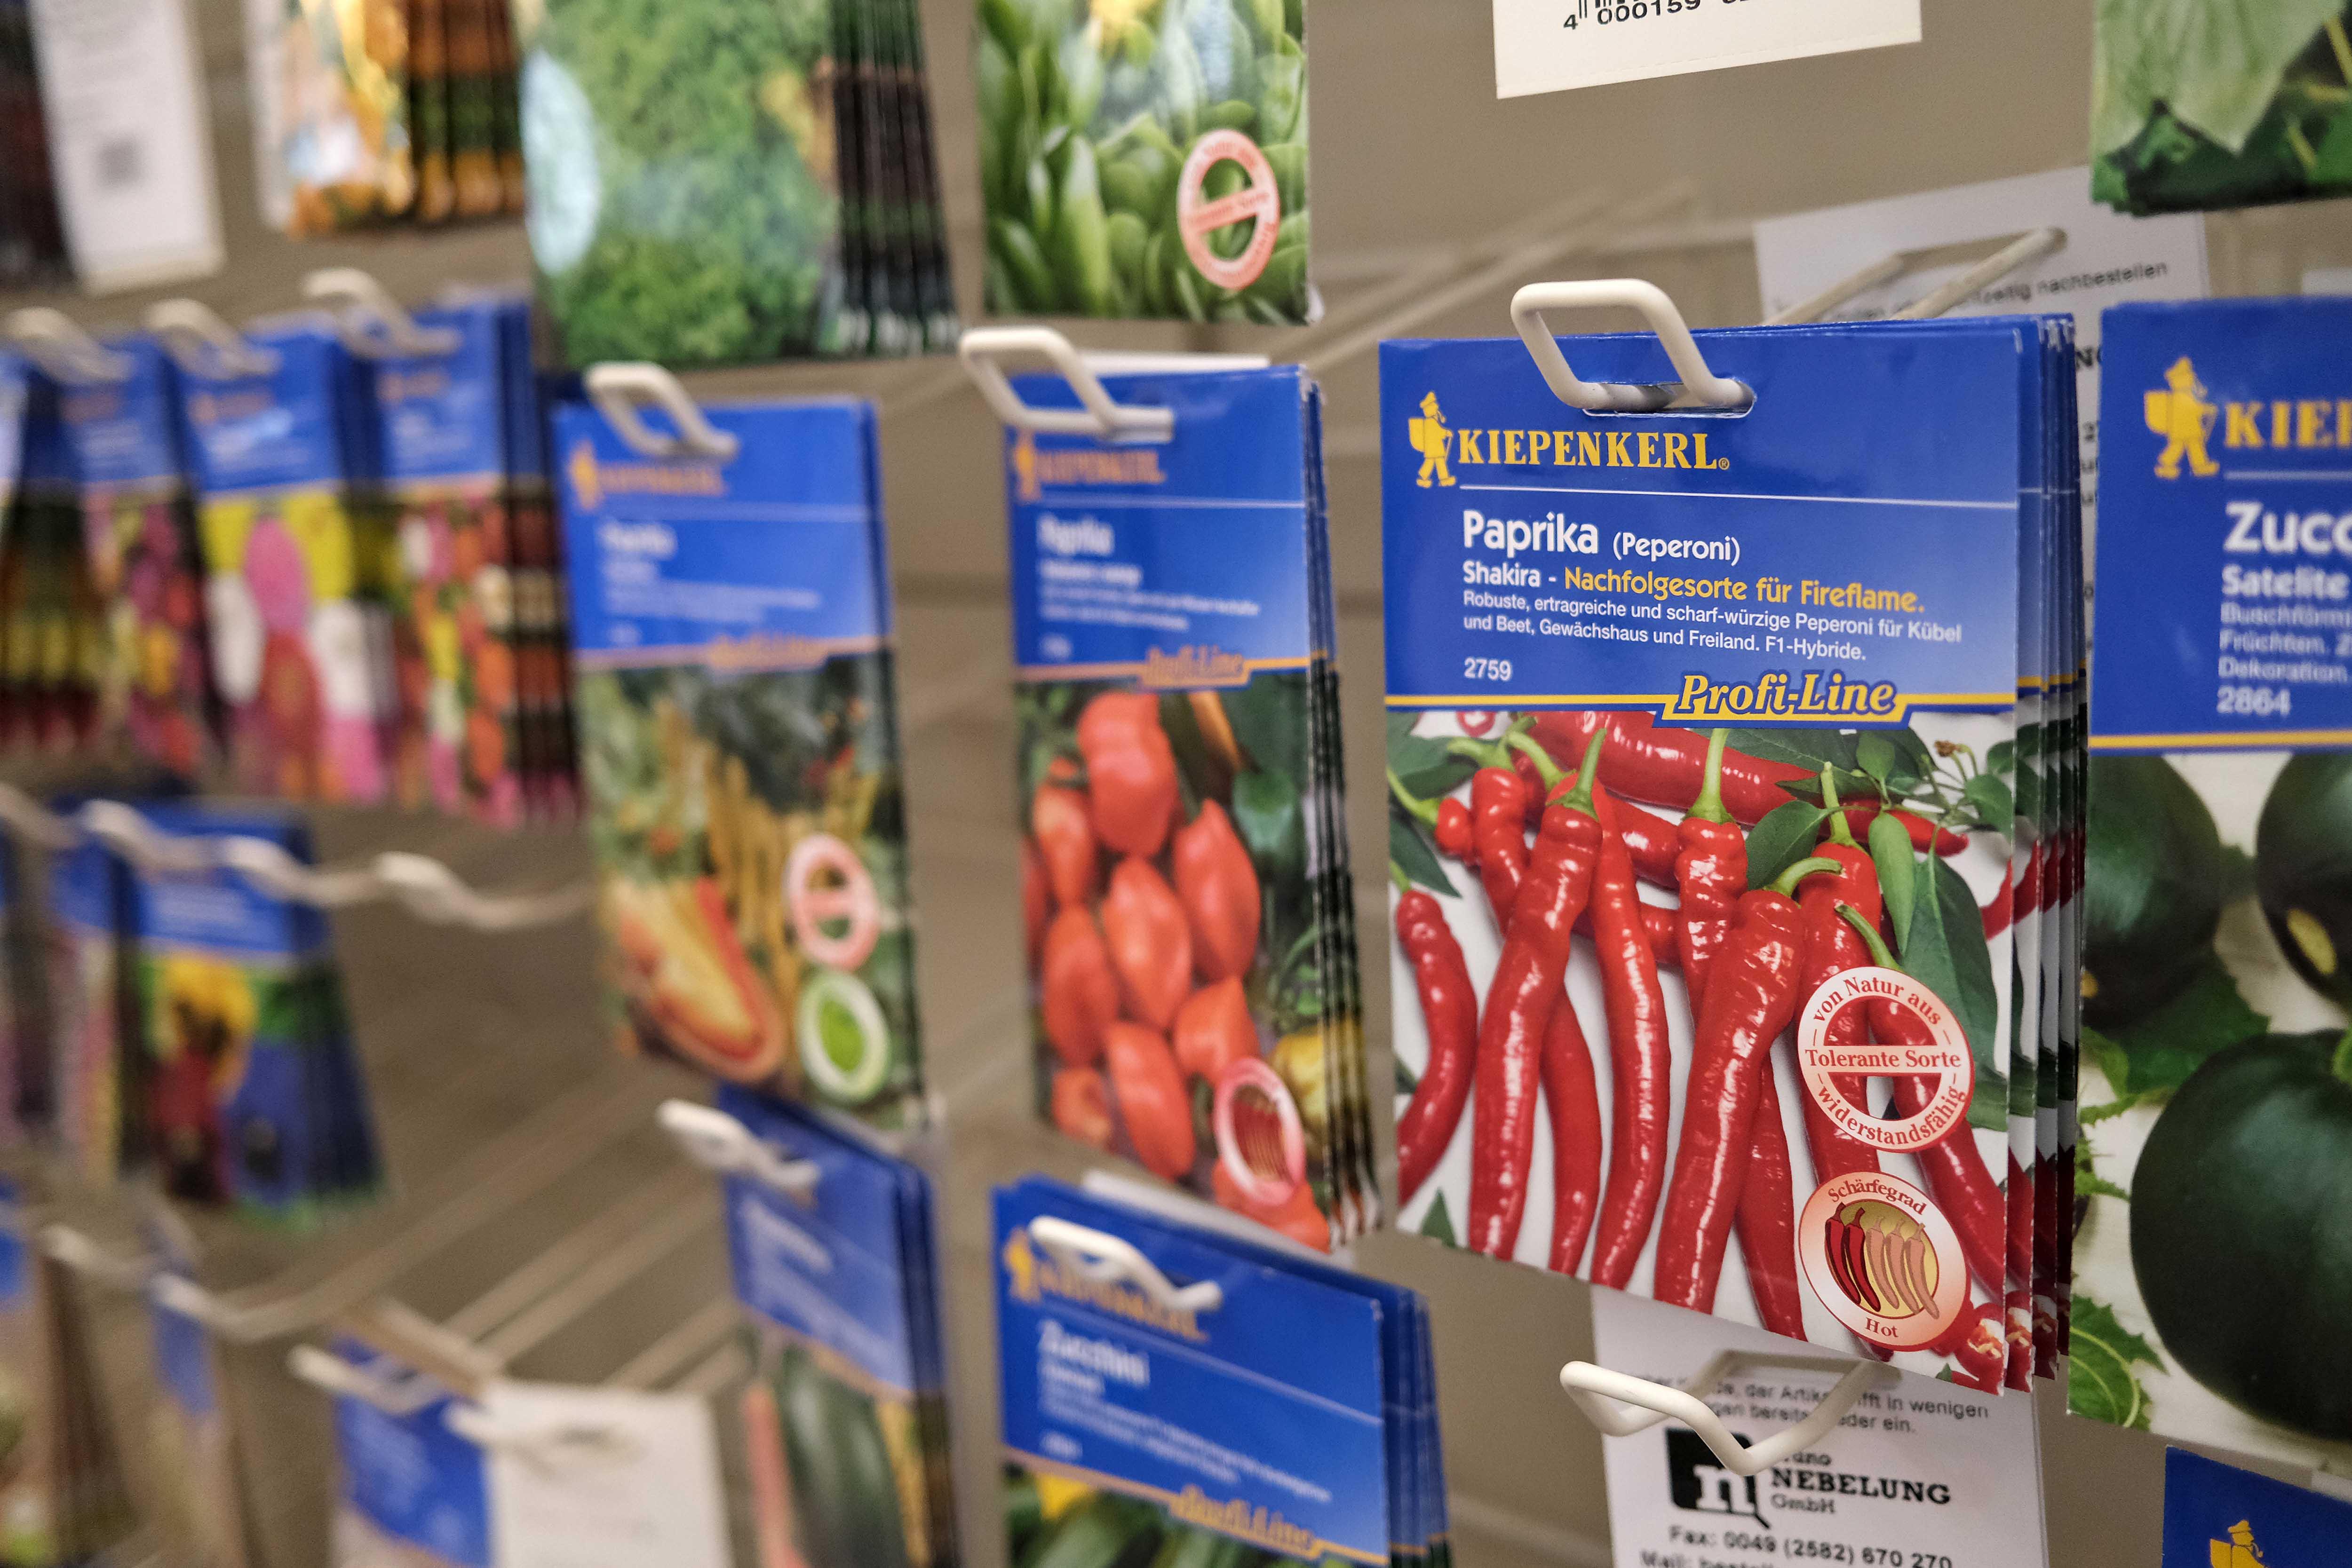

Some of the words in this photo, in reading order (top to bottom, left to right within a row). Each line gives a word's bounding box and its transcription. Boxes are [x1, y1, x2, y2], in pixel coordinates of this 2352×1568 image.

[1563, 14, 1578, 30] 4
[1463, 509, 1599, 559] Paprika
[1613, 531, 1740, 566] (Peperoni)
[1462, 560, 1541, 587] Shakira
[1565, 567, 1748, 601] Nachfolgesorte
[1756, 576, 1793, 603] für
[1801, 579, 1925, 613] Fireflame.
[1463, 590, 1530, 611] Robuste,
[1534, 596, 1626, 618] ertragreiche
[1630, 603, 1662, 619] und
[1666, 605, 1790, 632] scharf-würzige
[1795, 612, 1873, 635] Peperoni
[1878, 618, 1904, 638] für
[1907, 620, 1962, 643] Kübel
[1463, 615, 1492, 631] und
[1496, 616, 1535, 635] Beet,
[1539, 618, 1649, 643] Gewächshaus
[1653, 629, 1684, 645] und
[1689, 630, 1760, 651] Freiland.
[1765, 635, 1867, 661] F1-Hybride.
[1463, 657, 1512, 681] 2759
[1678, 673, 1894, 712] Profi-Line
[1813, 990, 1844, 1023] von
[1843, 976, 1905, 998] Natur
[1907, 993, 1941, 1025] aus
[1805, 1049, 1900, 1068] Tolerante
[1906, 1049, 1962, 1068] Sorte
[1818, 1086, 1966, 1145] widerstandsfähig
[1828, 1179, 1927, 1216] Schärfegrad
[1865, 1317, 1899, 1338] Hot
[1883, 1416, 1916, 1433] ein.
[1909, 1398, 1989, 1420] wenigen
[1770, 1466, 1951, 1505] NEBELUNG
[1771, 1493, 1836, 1513] GmbH
[1724, 1531, 1776, 1552] 0049
[1784, 1537, 1855, 1566] (2582)
[1862, 1546, 1903, 1568] 670
